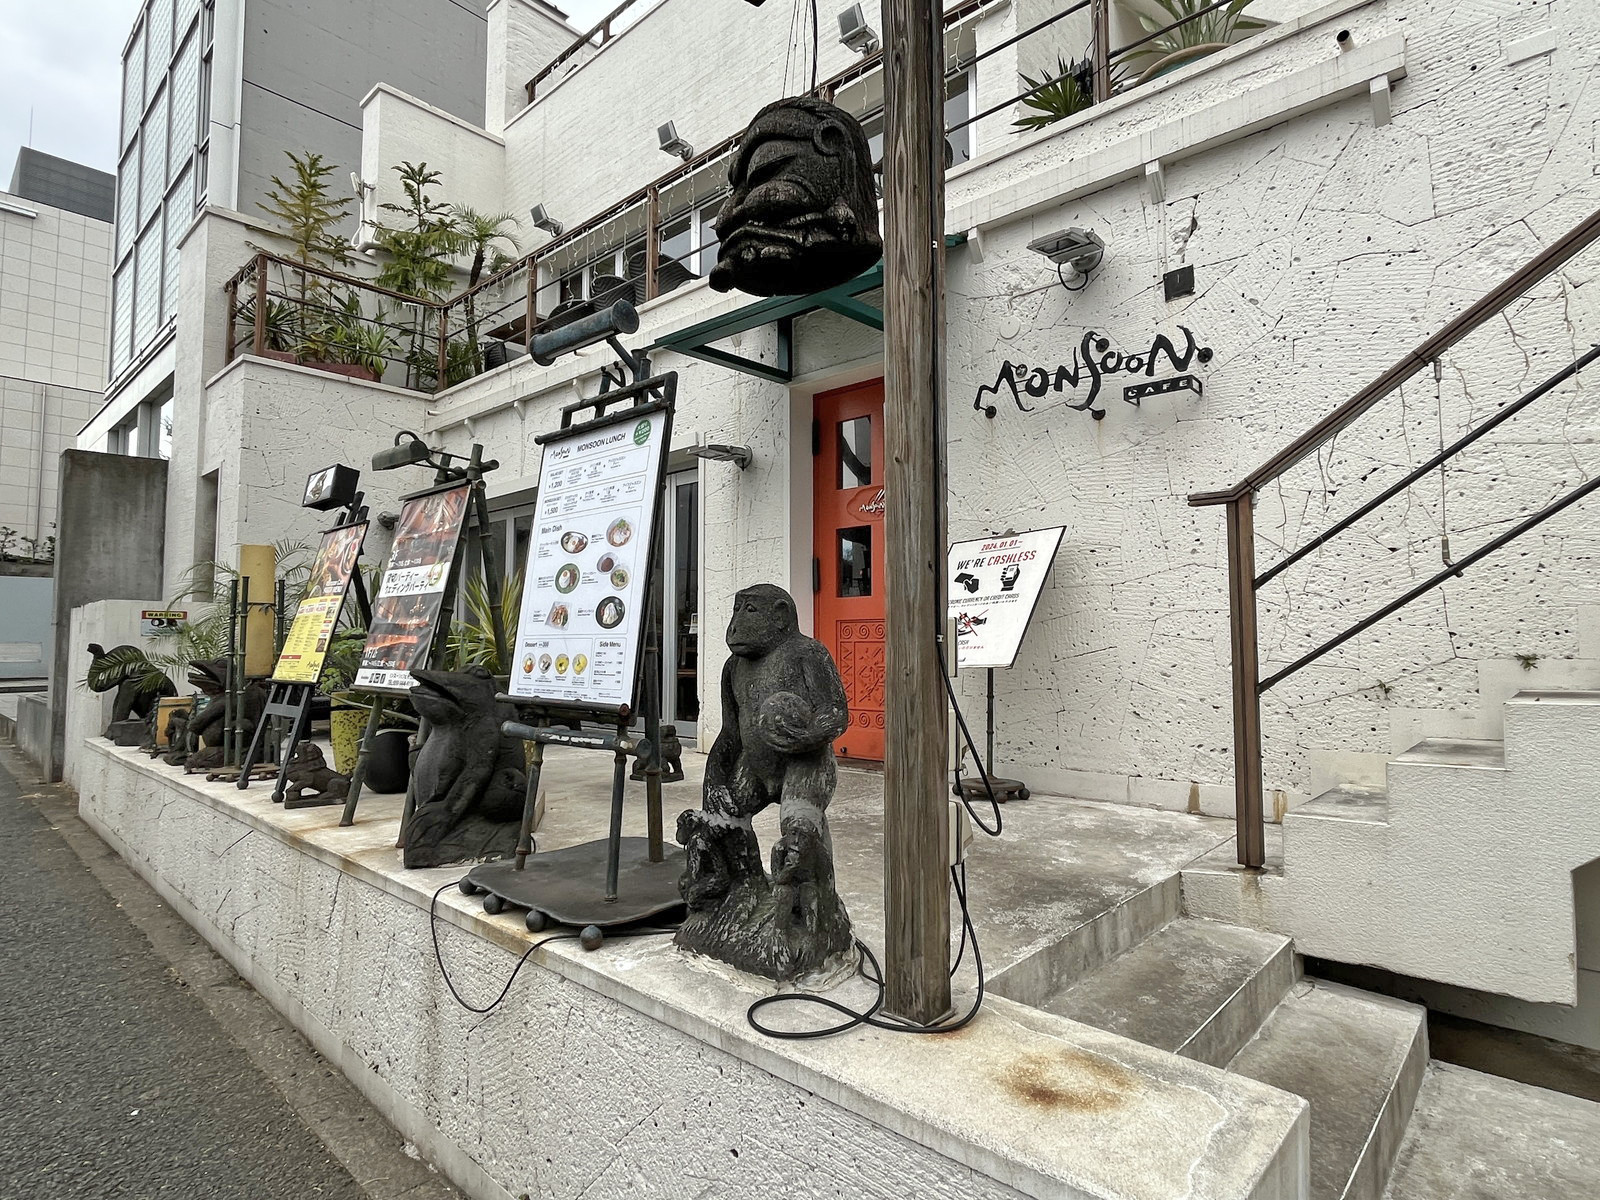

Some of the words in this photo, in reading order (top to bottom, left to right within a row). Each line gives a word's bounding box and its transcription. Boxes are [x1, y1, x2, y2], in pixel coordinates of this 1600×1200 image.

[1127, 379, 1189, 398] CAFE
[577, 439, 606, 452] MONSOON
[606, 433, 626, 445] LUNCH
[541, 526, 552, 534] Main
[957, 557, 986, 570] WE'RE
[987, 550, 1037, 566] CASHLESS
